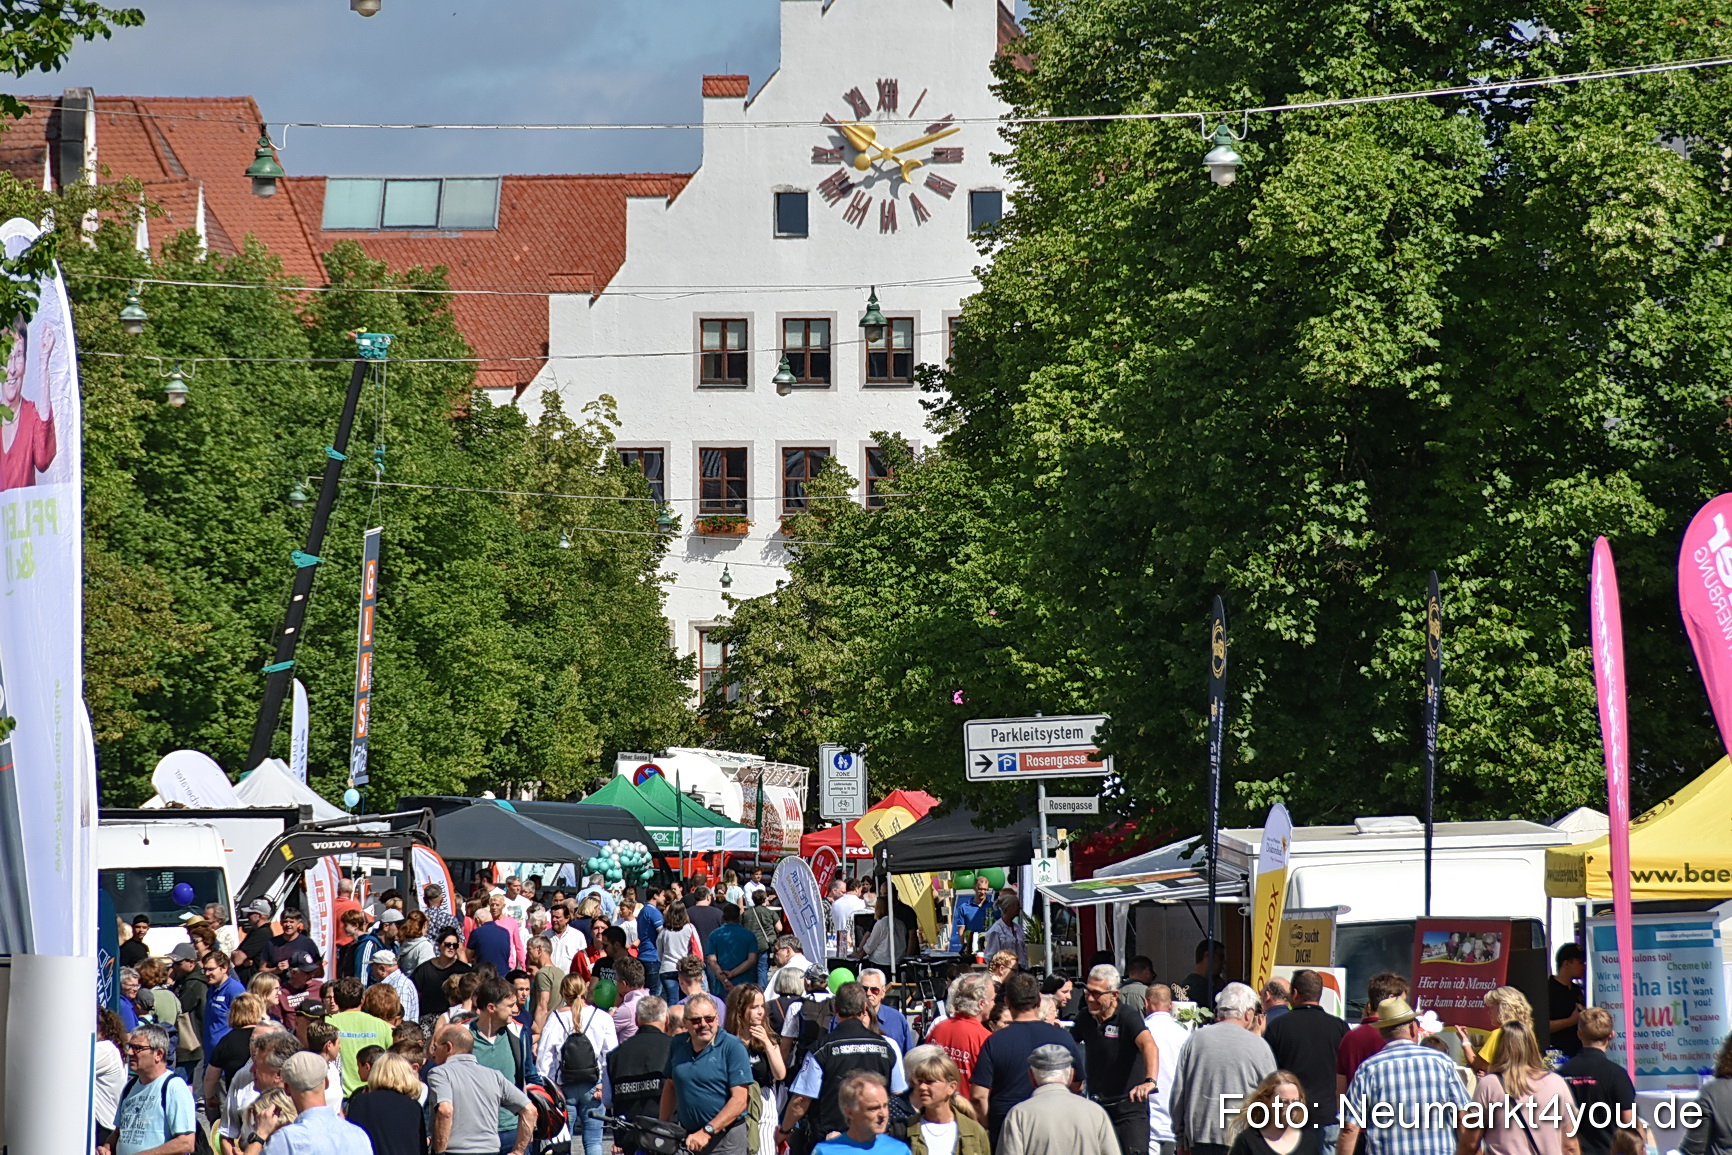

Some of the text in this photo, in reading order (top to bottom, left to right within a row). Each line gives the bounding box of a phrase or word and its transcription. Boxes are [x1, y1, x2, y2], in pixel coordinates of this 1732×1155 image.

[990, 726, 1084, 744] Parkleitsystem
[1025, 753, 1087, 769] Rosengasse
[783, 797, 801, 822] AVIA
[1049, 800, 1093, 813] Rosengasse
[651, 832, 670, 841] AOK
[311, 840, 352, 850] VOLVO
[313, 873, 328, 947] KLEBL
[1257, 882, 1280, 996] OTOBOX
[1304, 928, 1320, 943] sucht
[1295, 949, 1311, 963] DICH!
[1601, 952, 1672, 964] Nou oulons toi!
[1667, 962, 1700, 971] Chceme
[1596, 971, 1612, 981] Wir
[1691, 976, 1705, 985] We
[1418, 976, 1497, 990] Hier bin ich Mensch
[1598, 983, 1619, 993] Dich!
[1667, 976, 1689, 996] ist
[1693, 987, 1713, 997] want
[1434, 995, 1453, 1008] kann
[1454, 996, 1467, 1008] ich
[1693, 997, 1711, 1008] you!
[1650, 1041, 1667, 1052] dig!
[1677, 1037, 1709, 1047] Chceme
[1662, 1052, 1677, 1061] Mia
